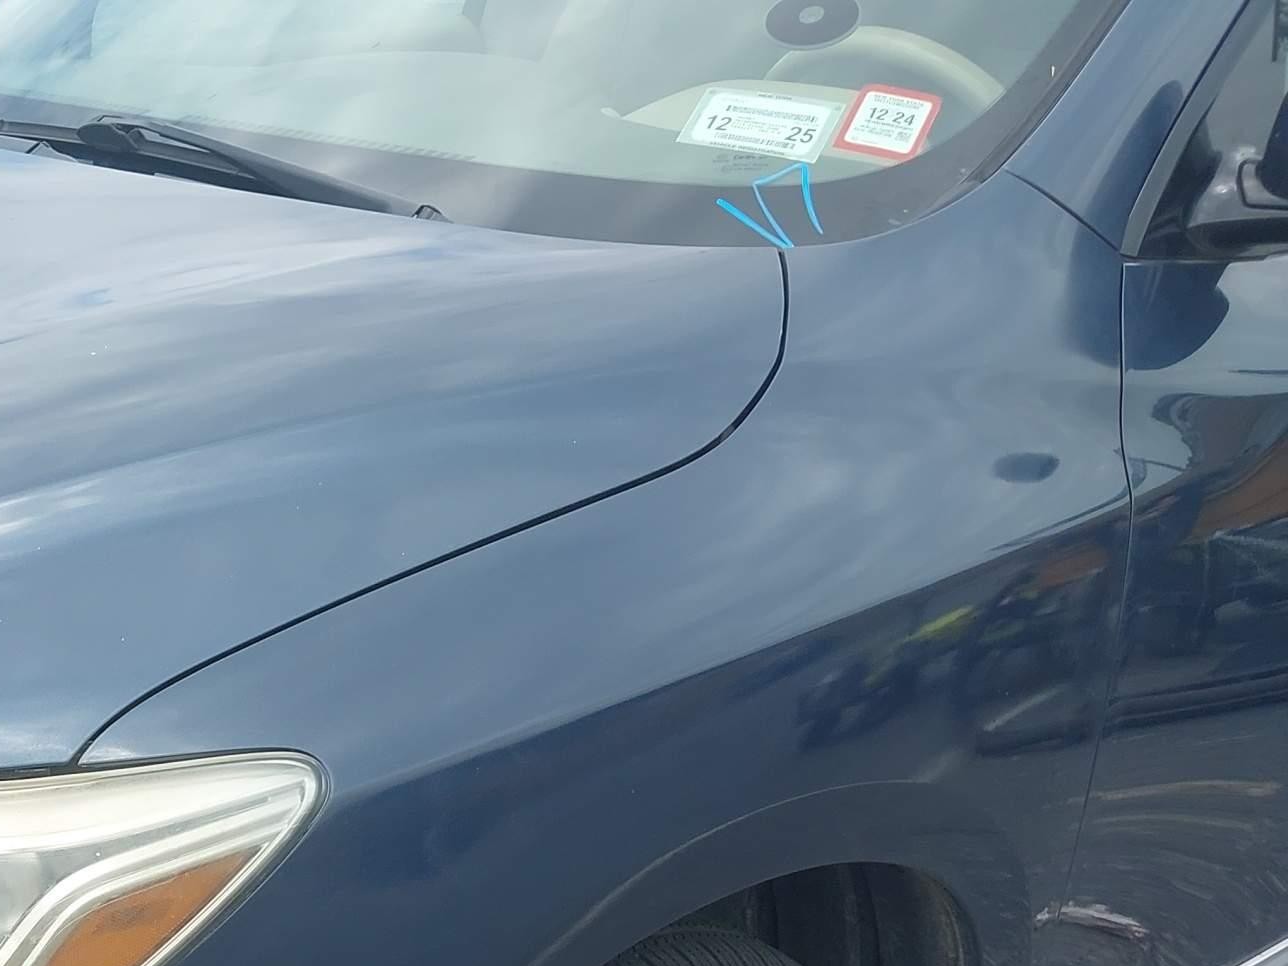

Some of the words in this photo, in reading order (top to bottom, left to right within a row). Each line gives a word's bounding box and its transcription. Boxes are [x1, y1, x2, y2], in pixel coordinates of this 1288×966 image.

[869, 106, 889, 121] 12
[892, 111, 916, 126] 24
[706, 114, 733, 131] 12
[784, 126, 817, 144] 25
